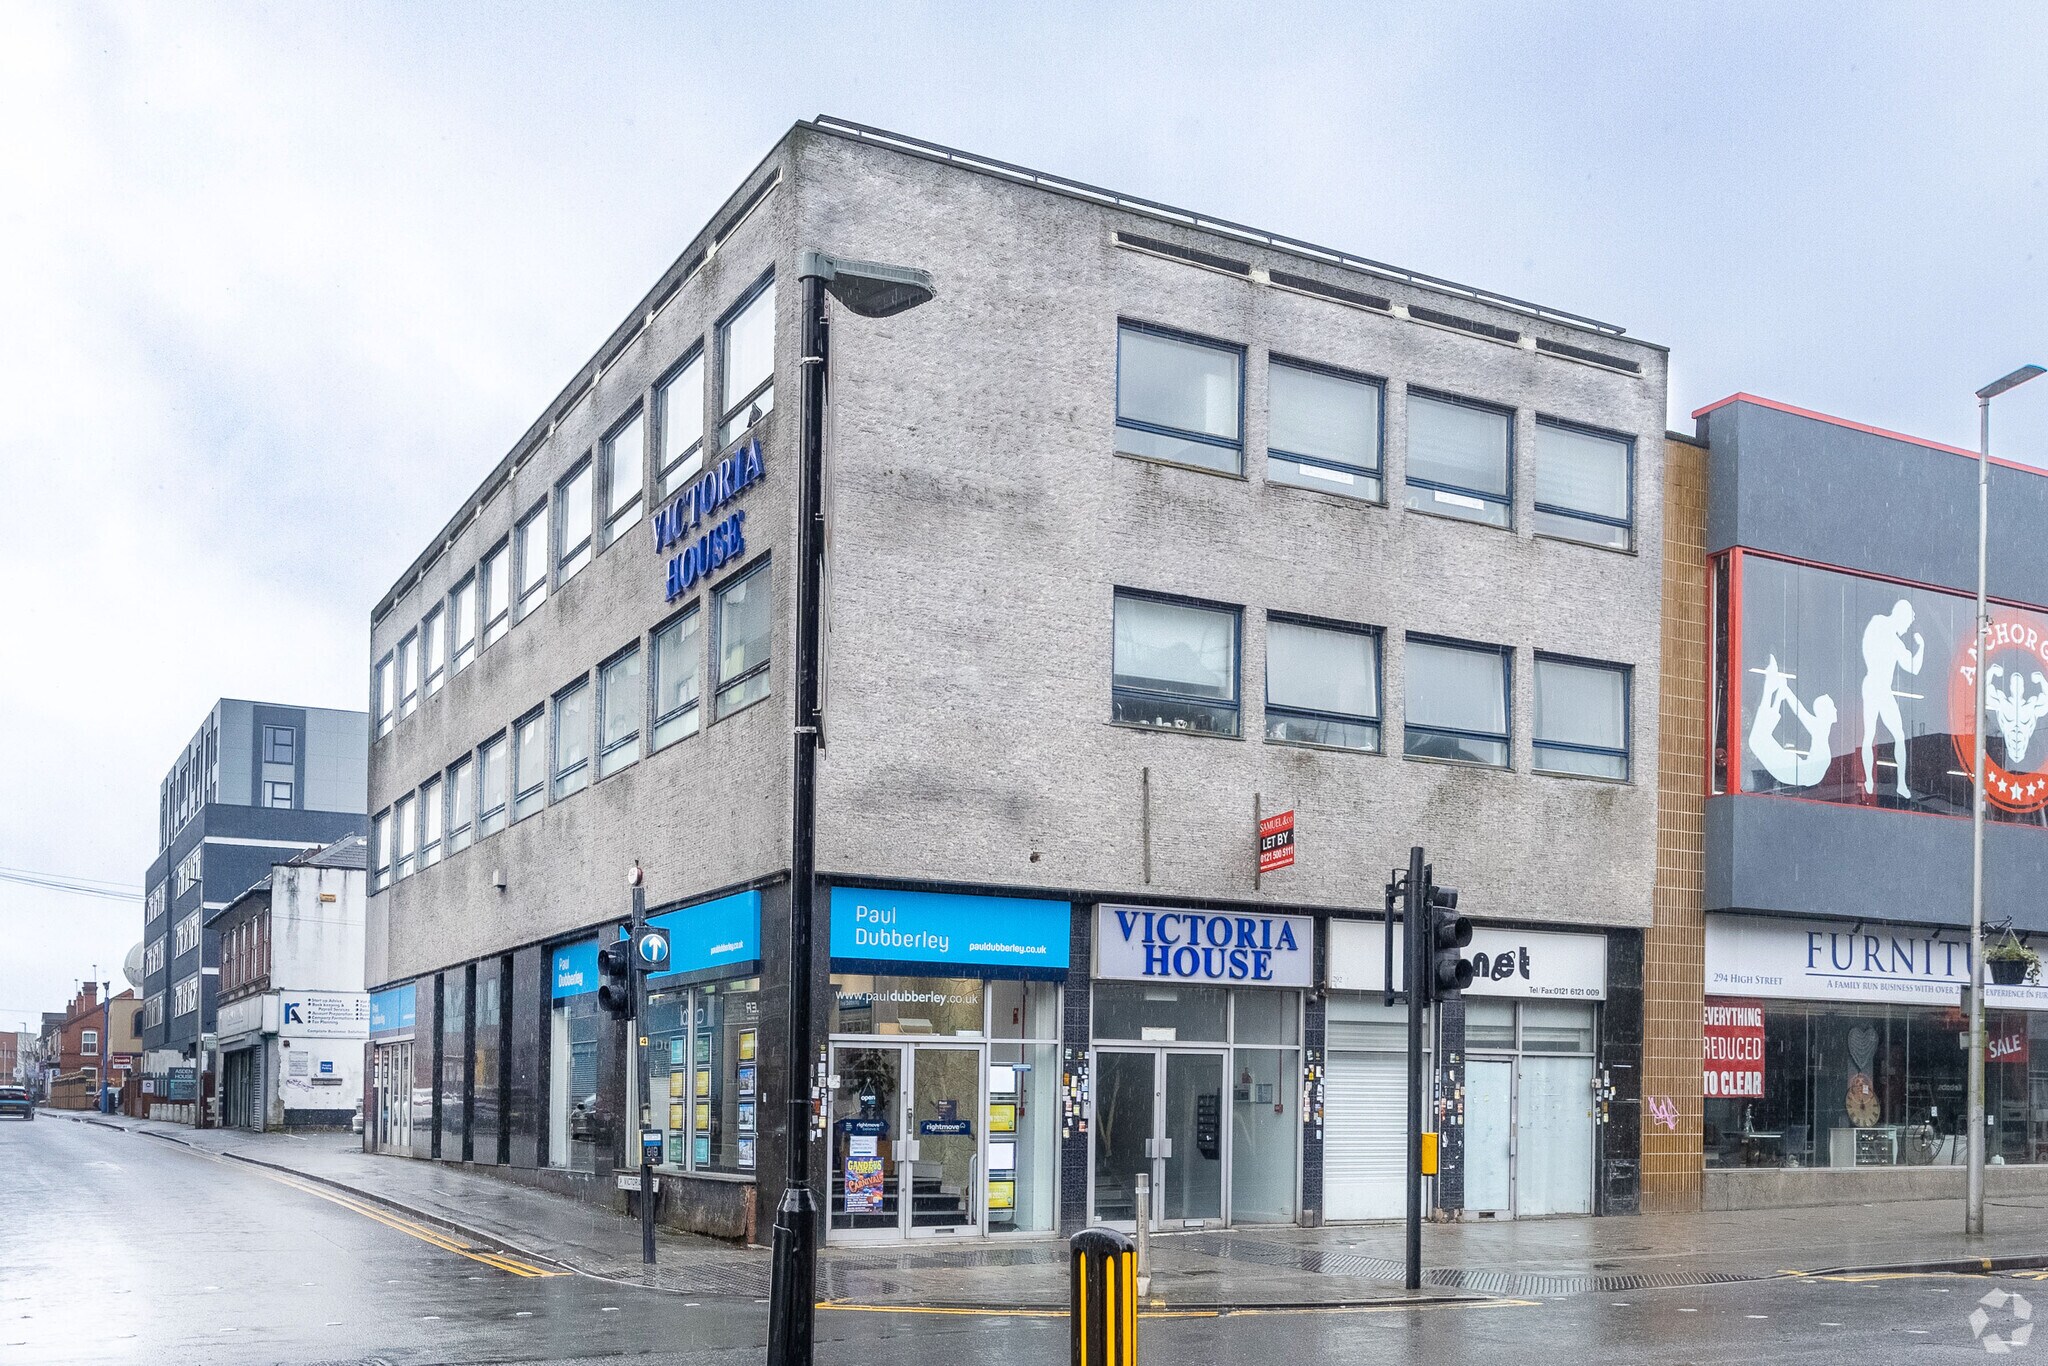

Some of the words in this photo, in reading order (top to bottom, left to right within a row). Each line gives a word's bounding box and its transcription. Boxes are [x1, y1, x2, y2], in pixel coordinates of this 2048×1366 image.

[653, 437, 766, 554] VICTORIA
[666, 509, 746, 602] HOUSE
[1260, 818, 1282, 832] SAMUEL
[1262, 836, 1276, 851] LET
[1278, 832, 1289, 846] BY
[1260, 853, 1272, 863] 0121
[1272, 850, 1282, 860] 500
[1282, 846, 1294, 857] 5111
[855, 905, 897, 925] Paul
[1115, 911, 1299, 950] VICTORIA
[855, 928, 950, 953] Dubberley
[969, 942, 1047, 955] pauldubberley.co.uk
[1142, 945, 1273, 980] HOUSE
[1713, 973, 1728, 983] 294
[1730, 974, 1753, 985] HIGH
[1755, 975, 1783, 985] STREET
[1827, 980, 1833, 989] A
[1834, 980, 1860, 990] FAMILY
[1862, 982, 1879, 990] RUN
[1880, 983, 1913, 992] BUSINESS
[1914, 985, 1934, 993] WITH
[1935, 985, 1954, 994] OVER
[835, 989, 978, 1006] www.pauldubberley.co.uk
[1586, 989, 1600, 997] 009
[1985, 989, 2025, 998] EXPERIENCE
[1704, 1006, 1763, 1027] EVERYTHING
[1703, 1036, 1762, 1060] REDUCED
[1988, 1034, 2021, 1059] SALE
[1703, 1071, 1719, 1095] TO
[1720, 1071, 1762, 1095] CLEAR
[857, 1121, 880, 1129] rightmove
[926, 1123, 960, 1133] rightmove
